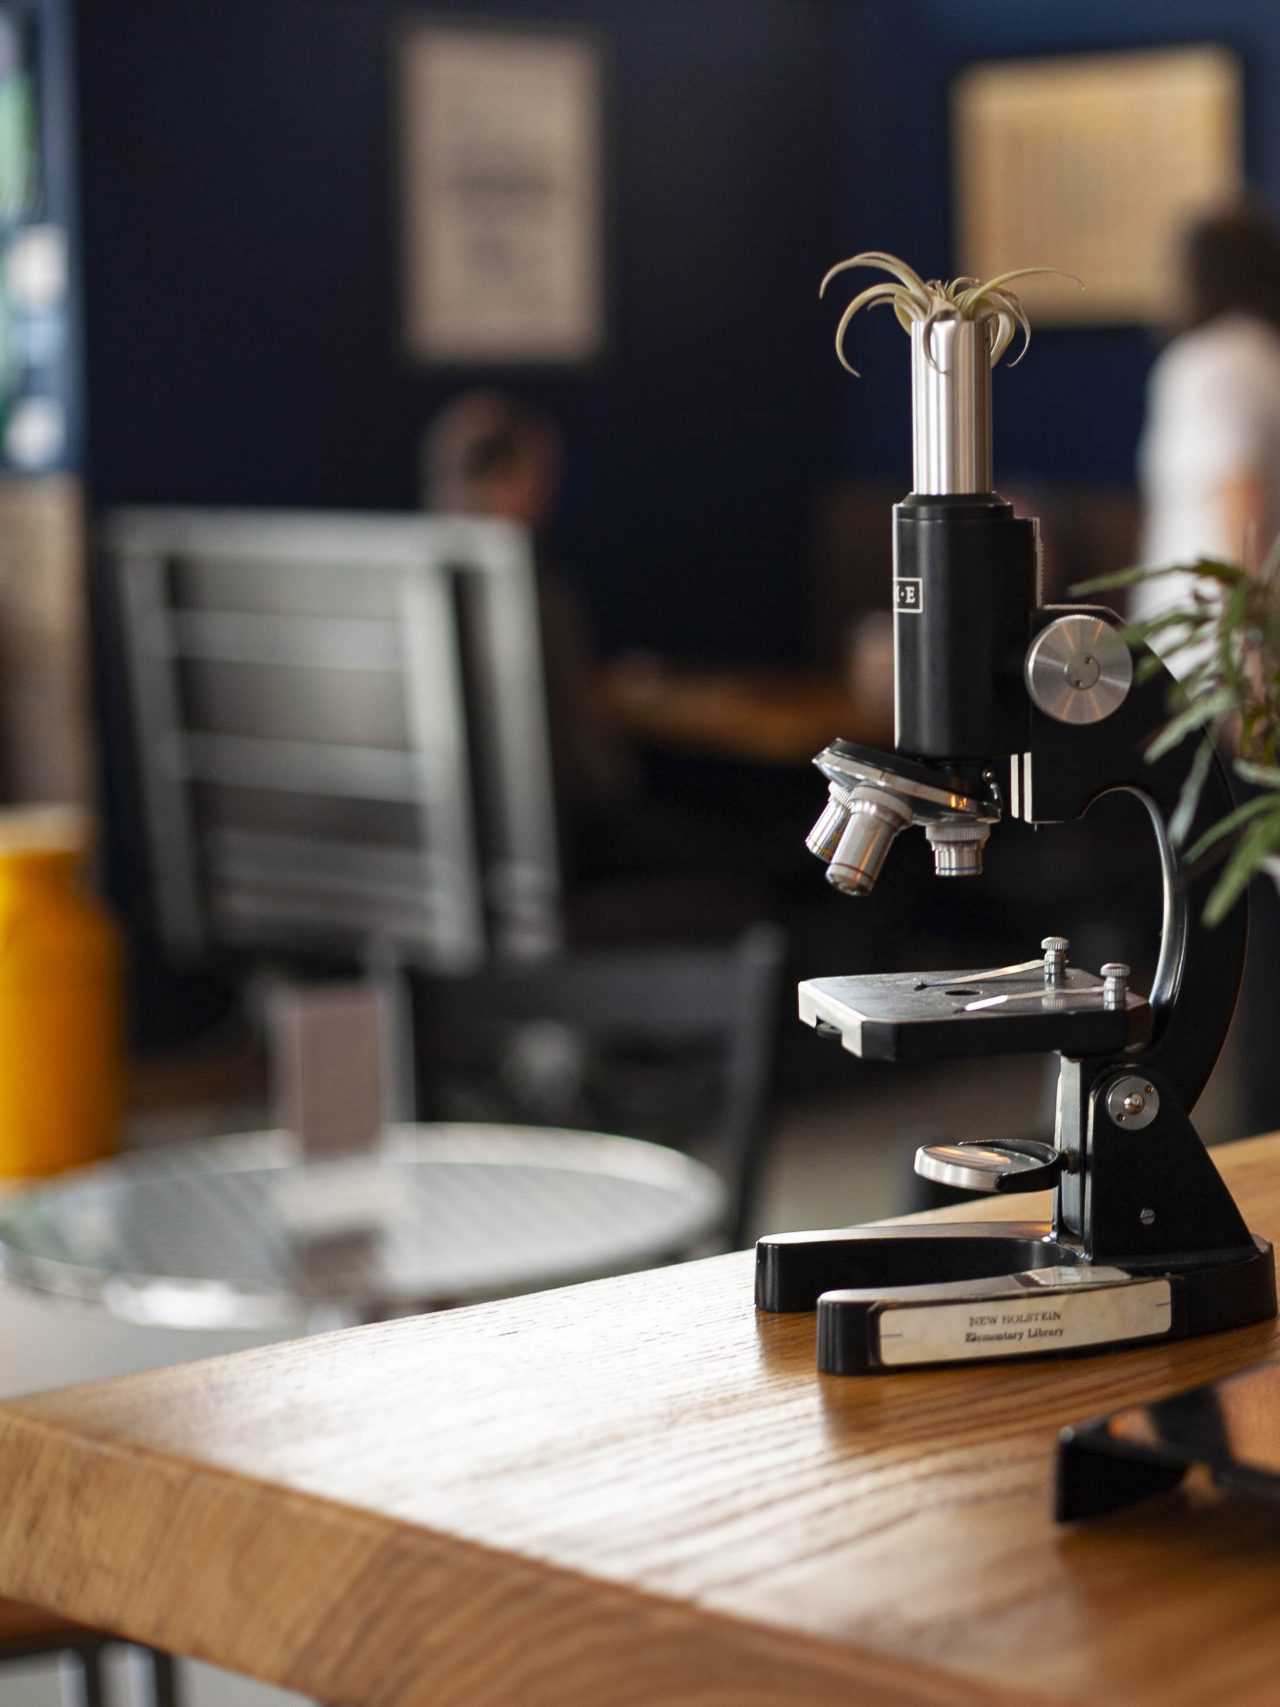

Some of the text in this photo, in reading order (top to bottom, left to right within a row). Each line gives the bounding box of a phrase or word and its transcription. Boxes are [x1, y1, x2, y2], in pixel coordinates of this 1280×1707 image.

[969, 1310, 1061, 1327] NEW HOLSTEIN
[965, 1327, 1065, 1343] Elementary Library
